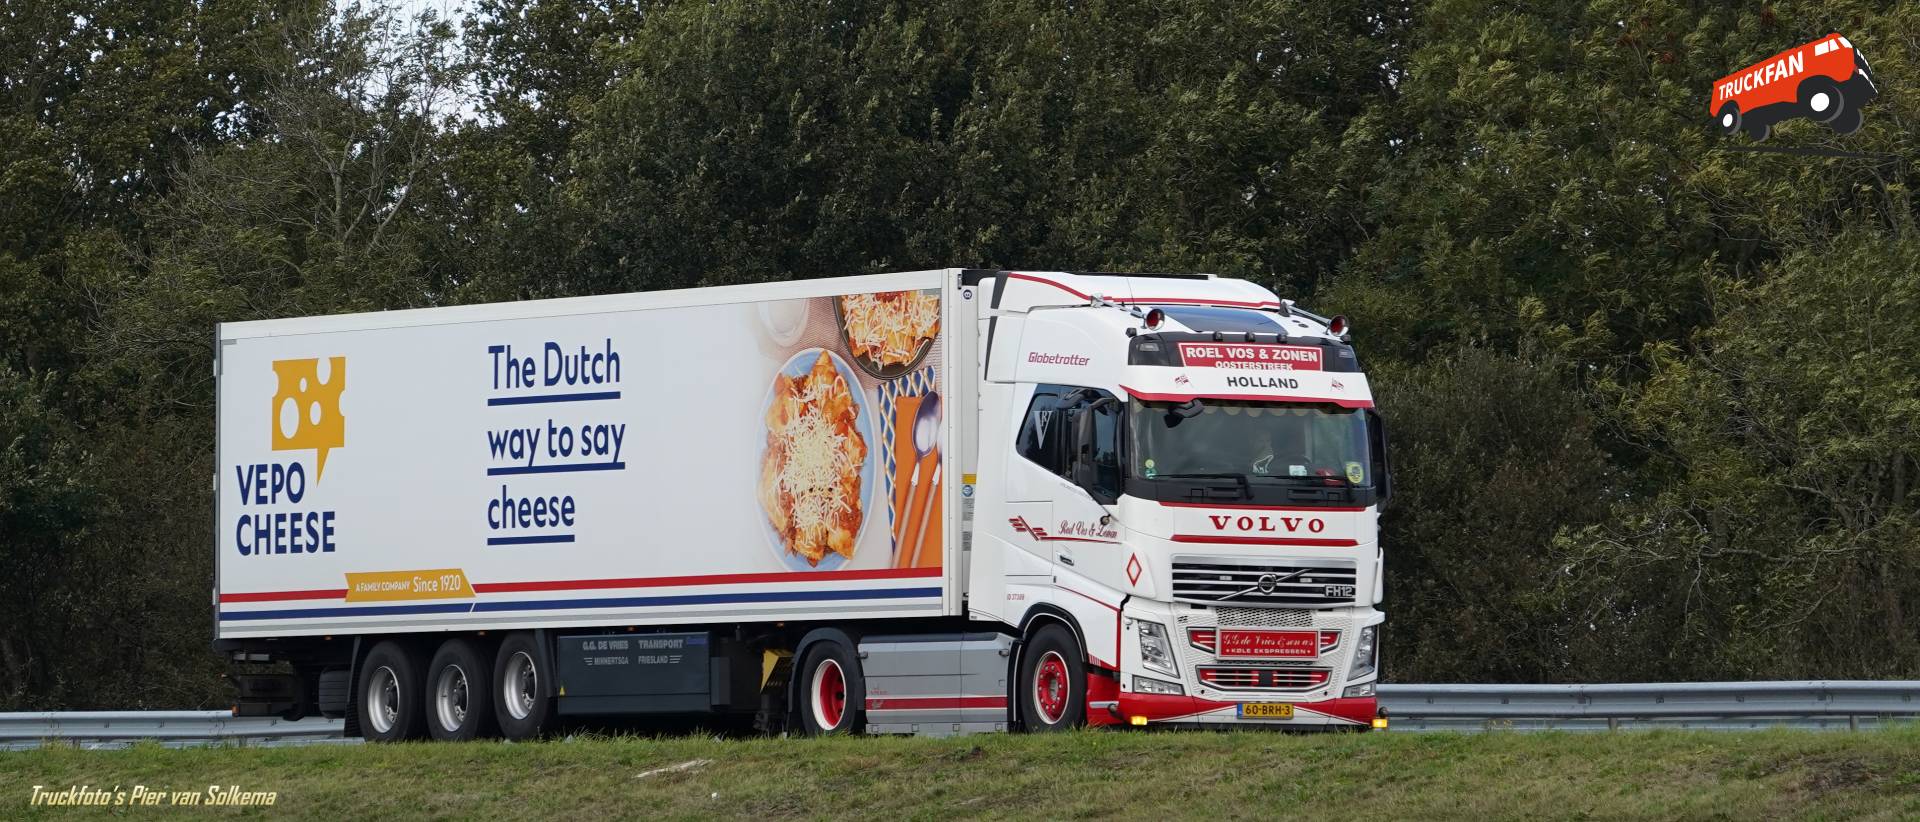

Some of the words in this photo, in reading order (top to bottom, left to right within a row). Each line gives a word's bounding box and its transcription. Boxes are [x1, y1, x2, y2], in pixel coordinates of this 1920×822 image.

[1027, 352, 1090, 366] Globetrotter
[1185, 347, 1223, 358] ROEL
[1225, 348, 1255, 360] VOS
[1258, 349, 1269, 360] &
[1272, 350, 1318, 362] ZONEN
[488, 344, 537, 391] The
[544, 338, 621, 388] Dutch
[1215, 361, 1294, 371] OOSTERSTREEK
[1226, 376, 1299, 389] HOLLAND
[487, 427, 541, 467] way
[547, 419, 574, 458] to
[580, 422, 626, 464] say
[236, 461, 306, 506] VEPO
[487, 485, 576, 530] cheese
[1088, 523, 1096, 537] &
[1208, 515, 1325, 533] VOLVO
[236, 510, 336, 556] CHEESE
[355, 583, 361, 592] A
[360, 582, 381, 592] FAMILY
[381, 581, 410, 591] COMPANY
[413, 576, 438, 593] Since
[440, 574, 461, 591] 1920
[1325, 586, 1353, 597] FH12
[608, 640, 629, 650] VRIES
[638, 639, 684, 649] TRANSPORT
[638, 655, 668, 664] FRIESLAND
[1245, 704, 1291, 715] 60-BRH-3
